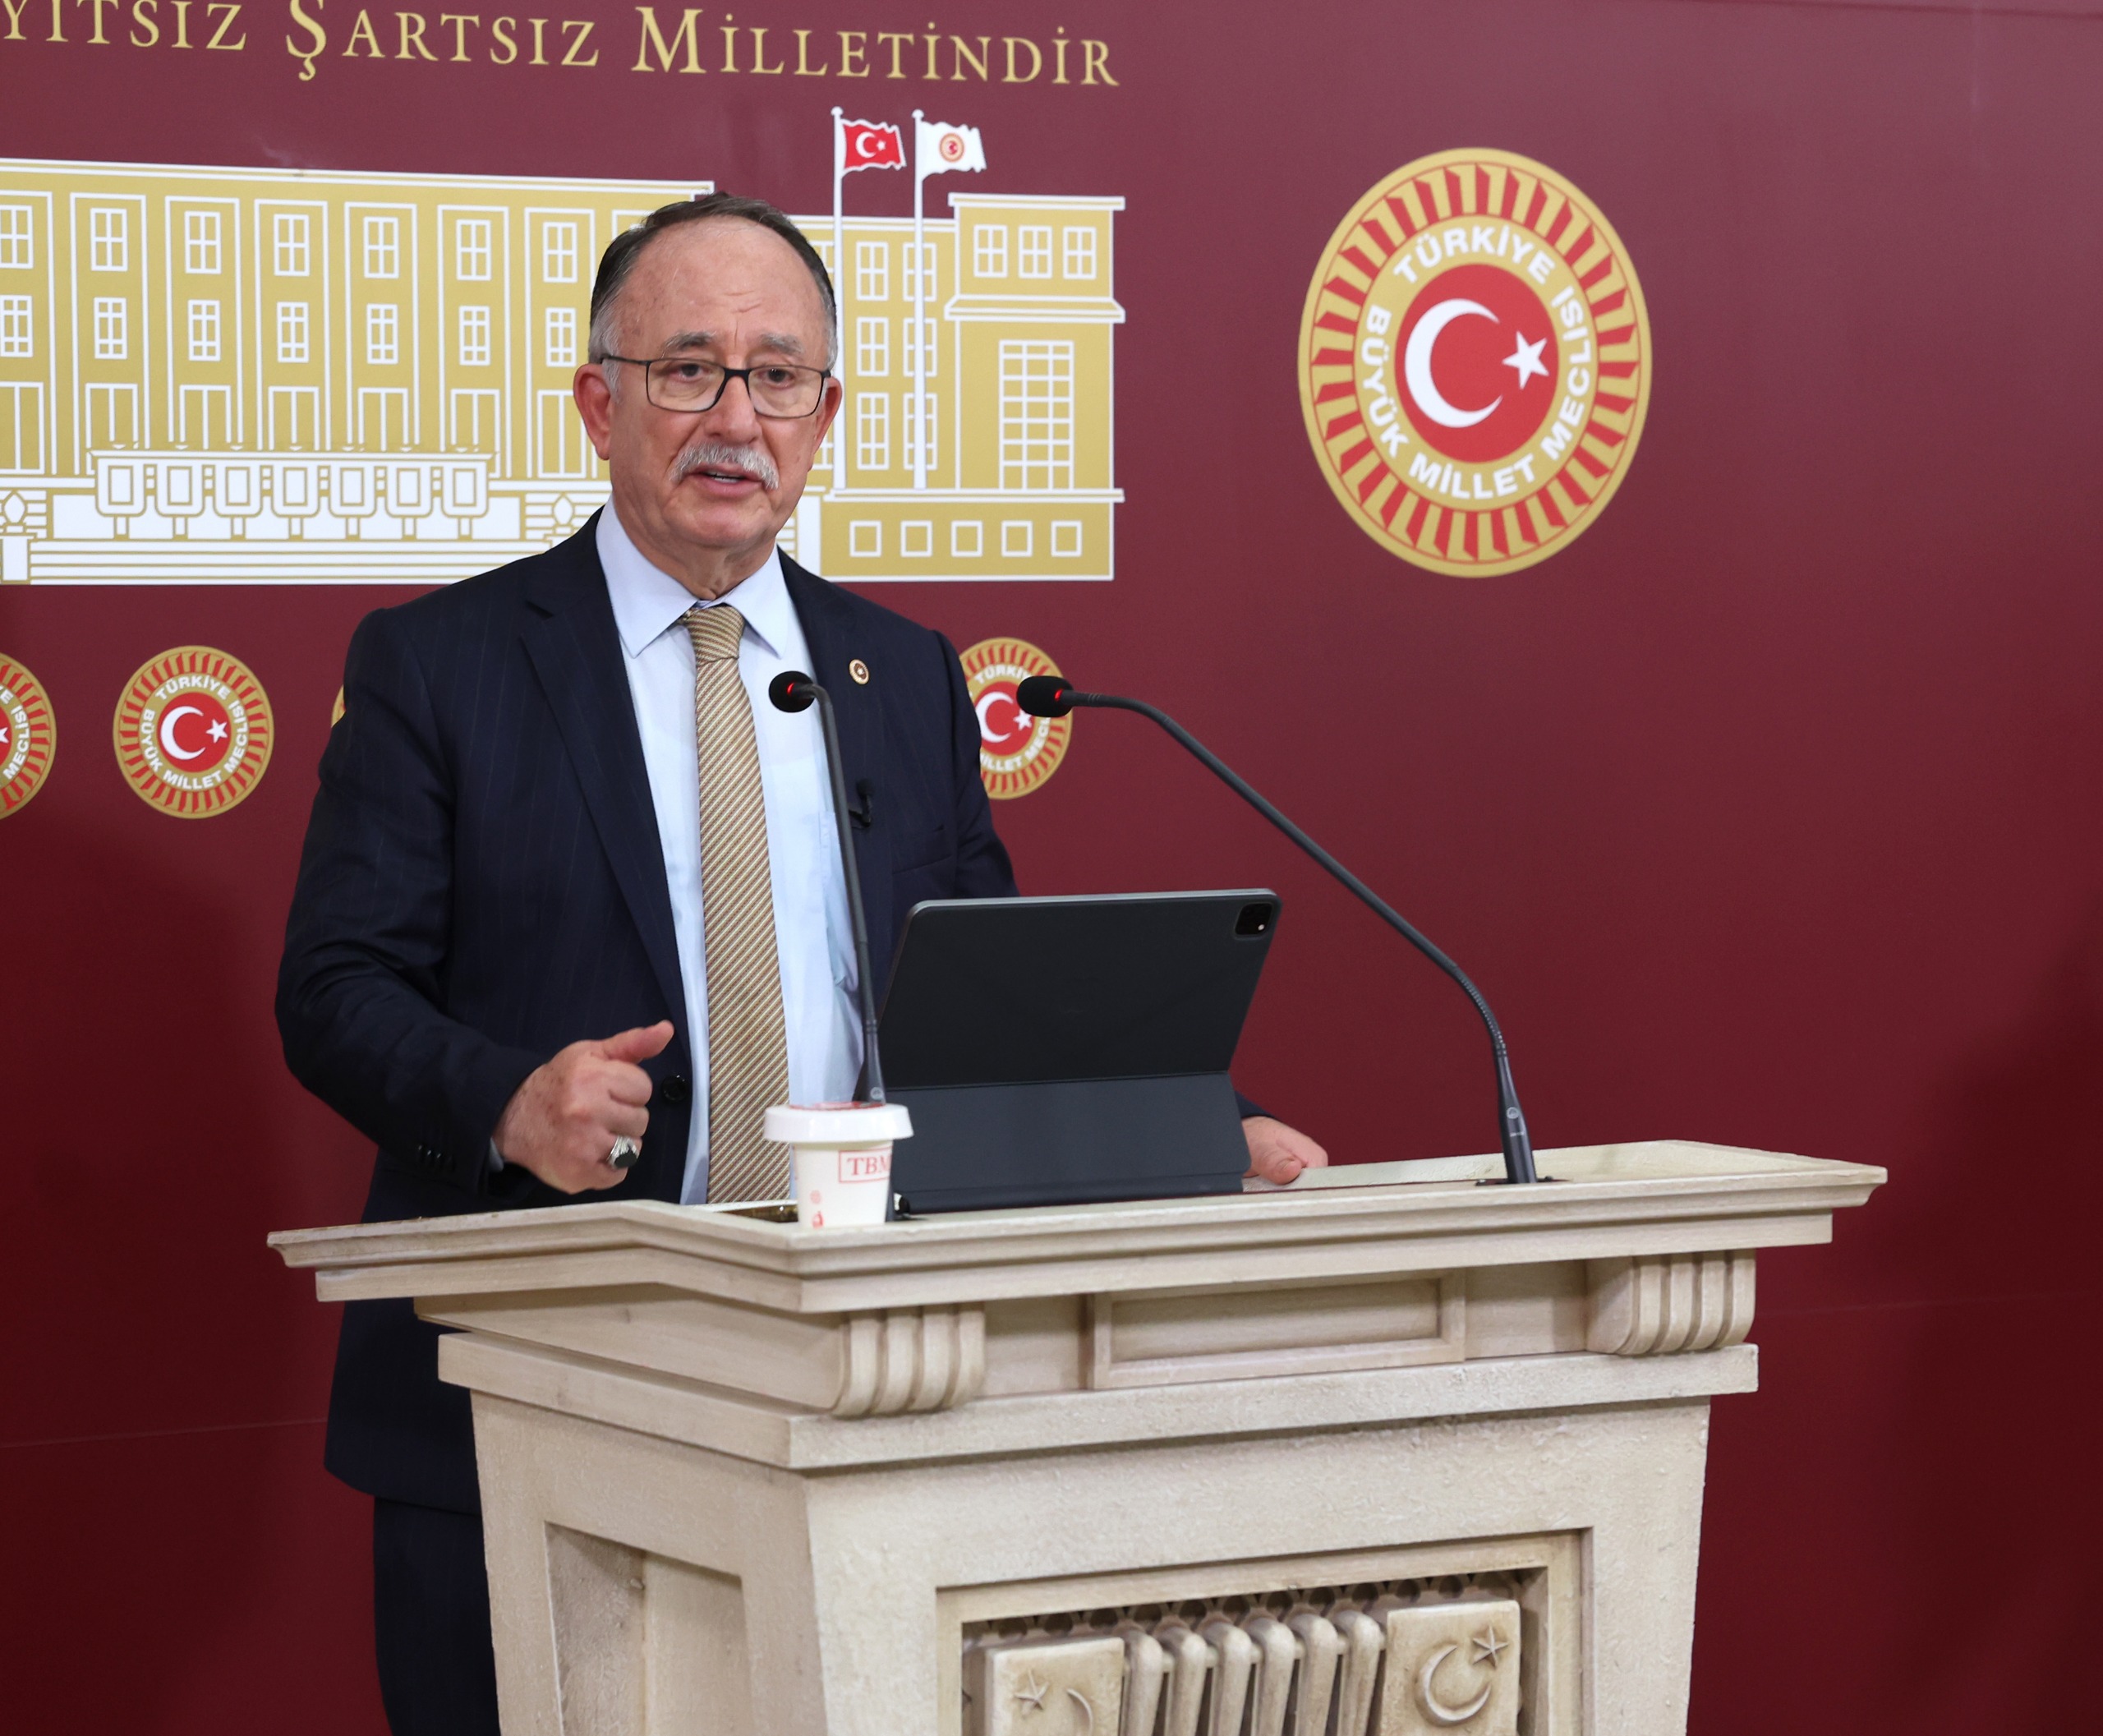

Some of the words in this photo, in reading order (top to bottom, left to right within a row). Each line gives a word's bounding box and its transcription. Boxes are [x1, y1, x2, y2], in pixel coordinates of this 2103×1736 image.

[285, 0, 600, 81] ŞARTSIZ
[631, 6, 1120, 86] MİLLETİNDİR
[1392, 223, 1556, 285] TÜRKİYE
[1360, 305, 1410, 458] BÜYÜK
[1409, 452, 1536, 500] MİLLET
[154, 675, 231, 700] TÜRKİYE
[974, 663, 1033, 684] TÜRKİ
[140, 708, 163, 772] BÜYÜK
